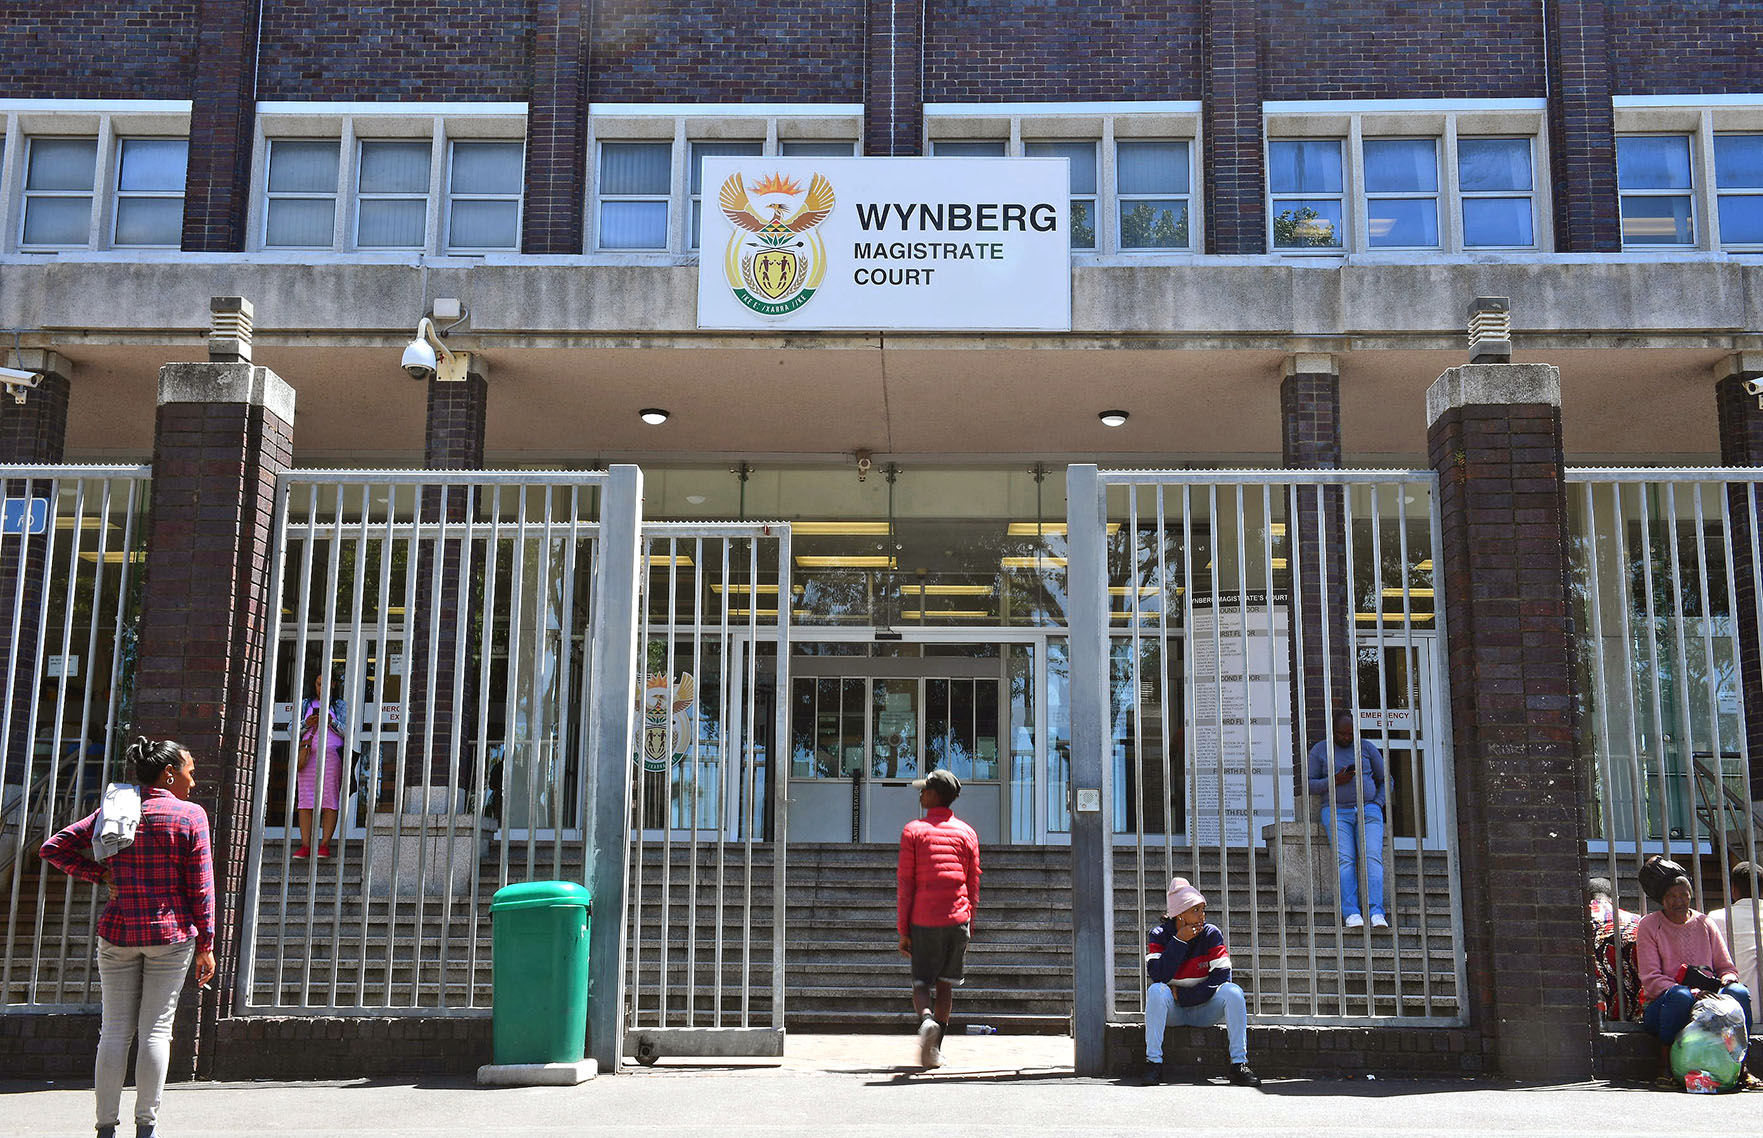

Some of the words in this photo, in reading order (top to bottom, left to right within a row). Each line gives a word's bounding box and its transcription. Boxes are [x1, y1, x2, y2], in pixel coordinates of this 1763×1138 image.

[855, 203, 1057, 232] WYNBERG
[854, 242, 1004, 260] MAGISTRATE
[854, 268, 935, 286] COURT
[1218, 594, 1264, 602] MAGISTATE'S
[1361, 711, 1409, 719] EMERENCY
